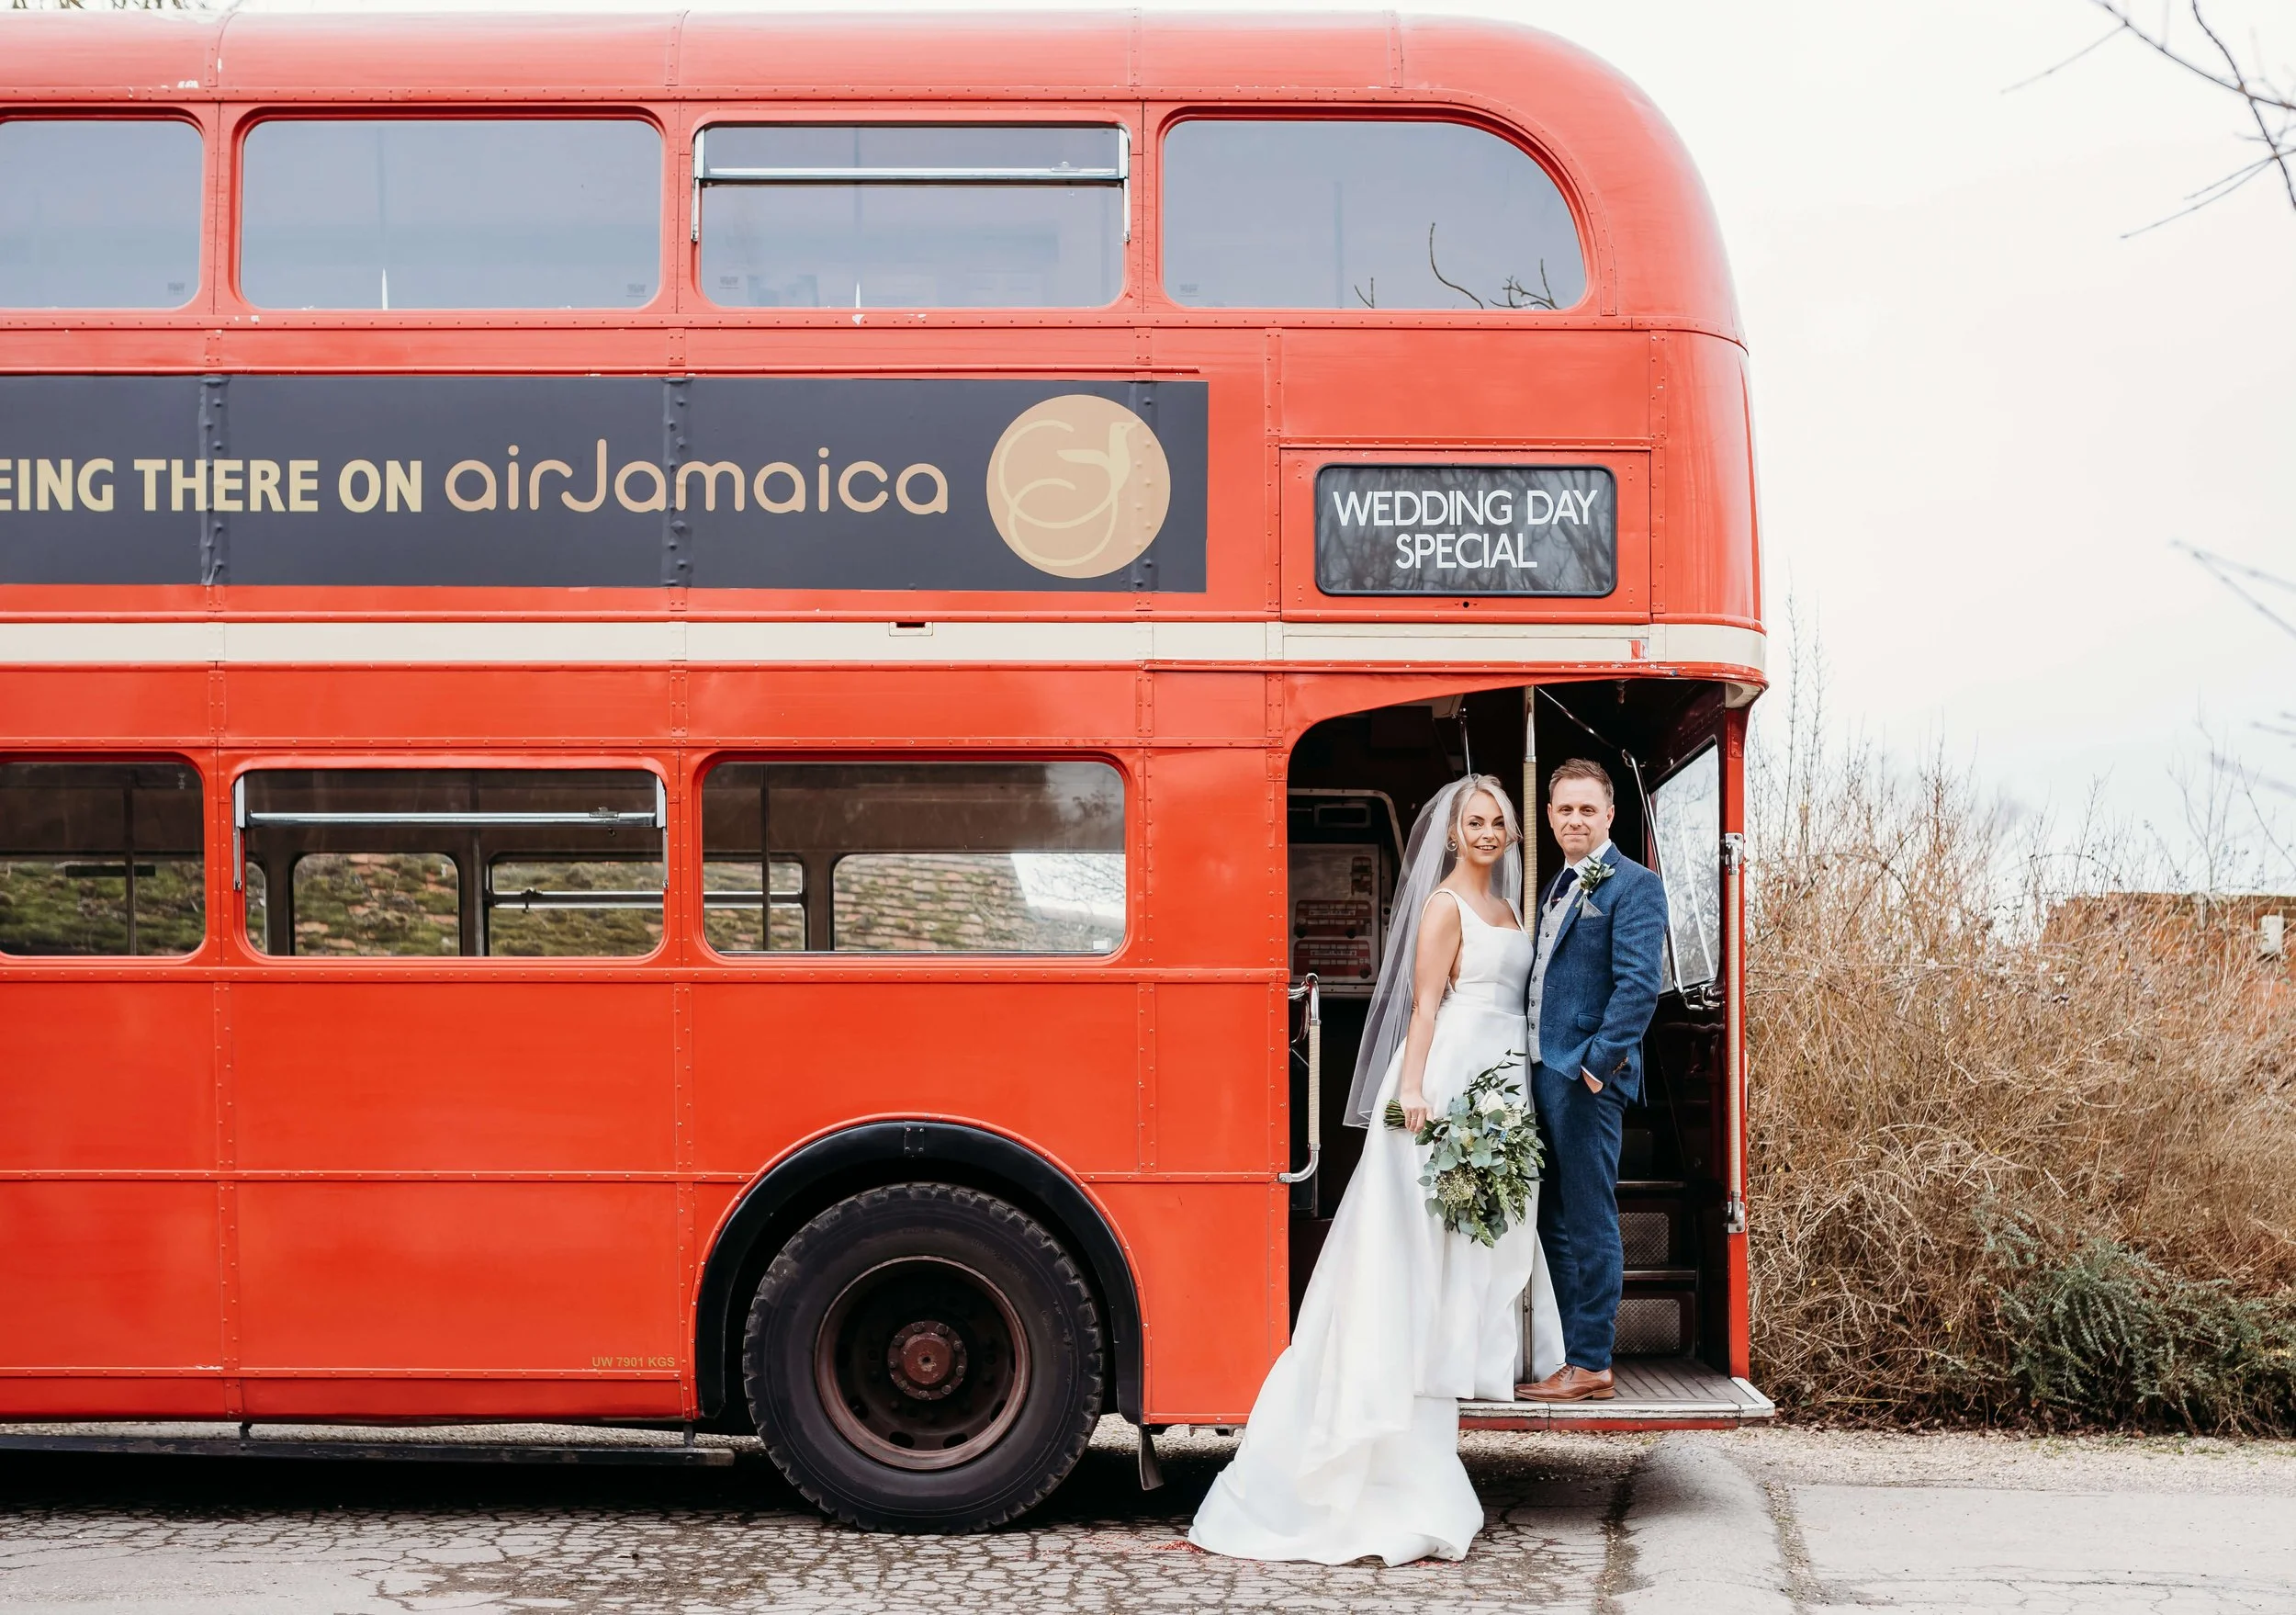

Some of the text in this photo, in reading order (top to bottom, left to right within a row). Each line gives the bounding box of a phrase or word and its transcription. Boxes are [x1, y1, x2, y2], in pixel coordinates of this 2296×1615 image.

[134, 458, 319, 512] THERE
[338, 459, 422, 513] ON
[1333, 489, 1599, 526] WEDDING DAY
[1395, 532, 1538, 570] SPECIAL
[591, 1356, 676, 1368] UW 7901 KGS
